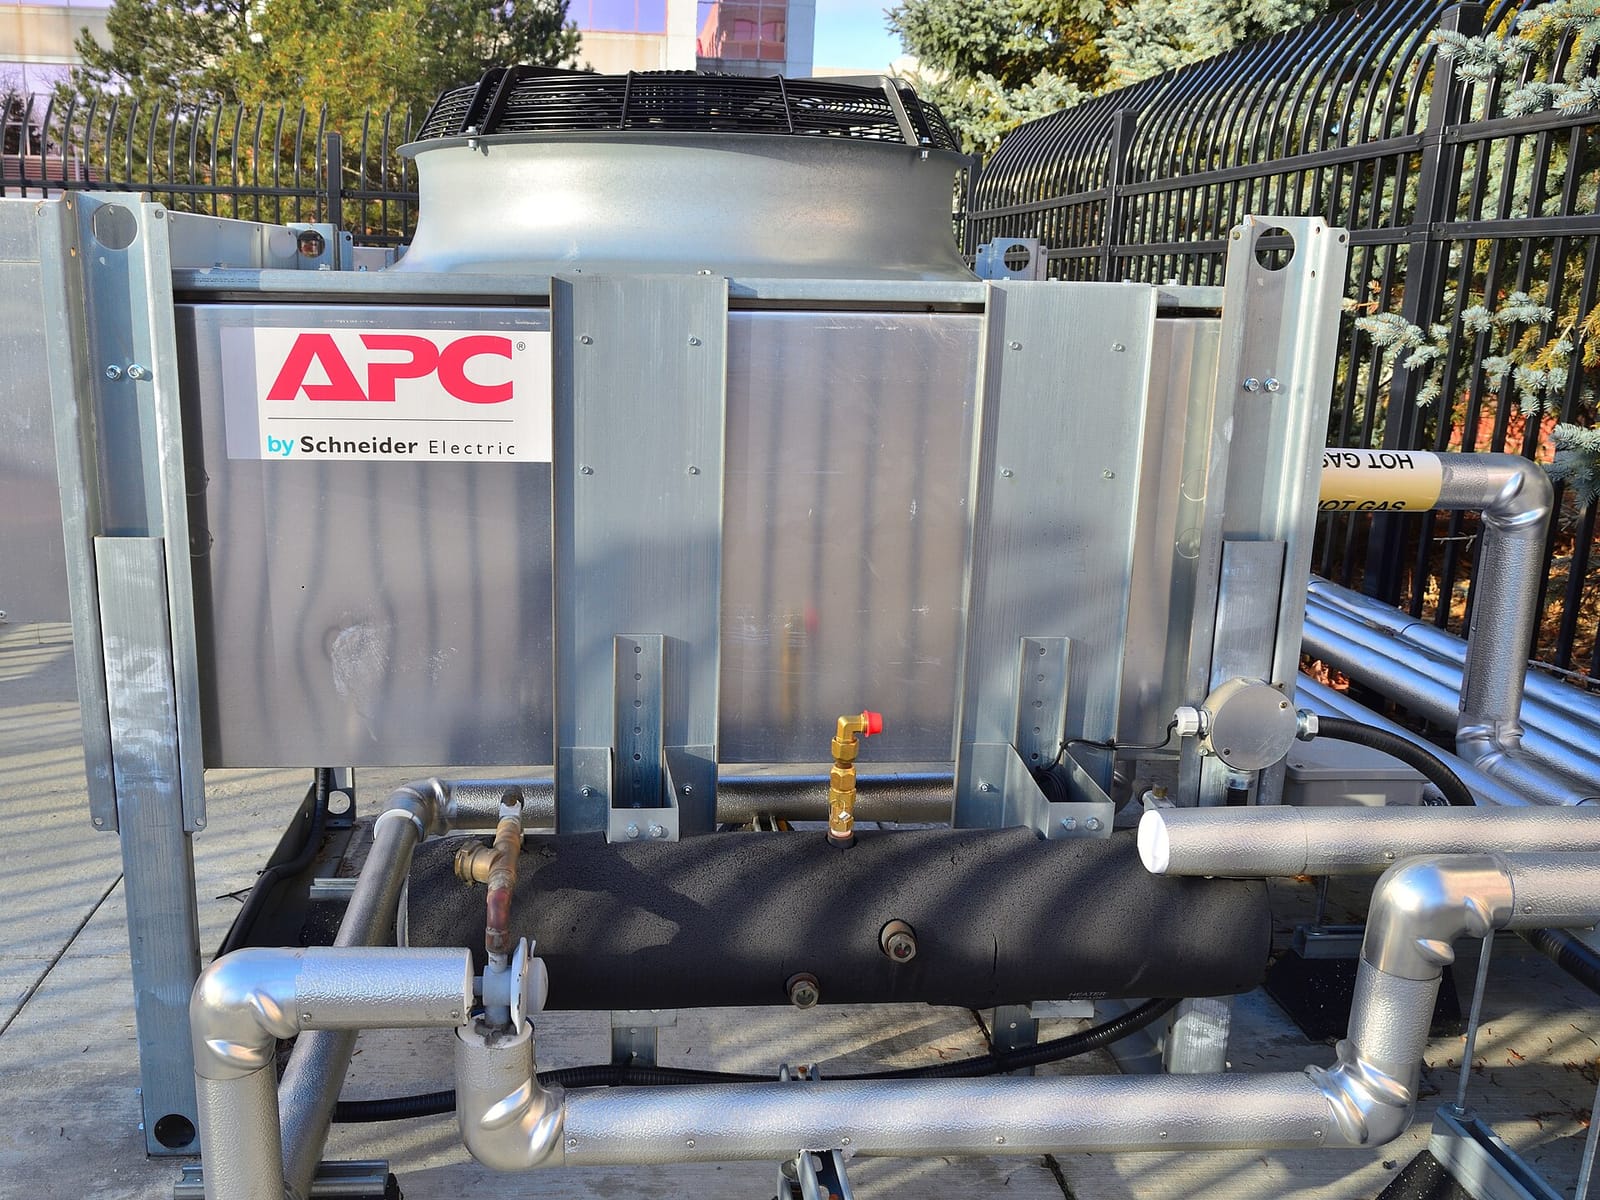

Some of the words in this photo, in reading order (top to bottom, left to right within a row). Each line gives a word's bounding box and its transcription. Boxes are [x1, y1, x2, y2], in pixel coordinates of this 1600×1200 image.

[266, 333, 514, 404] APC
[267, 435, 294, 456] by
[300, 436, 418, 455] Schneider
[429, 440, 515, 455] Electric
[1368, 453, 1414, 469] HOT
[1318, 500, 1356, 511] OT
[1357, 500, 1406, 511] GAS
